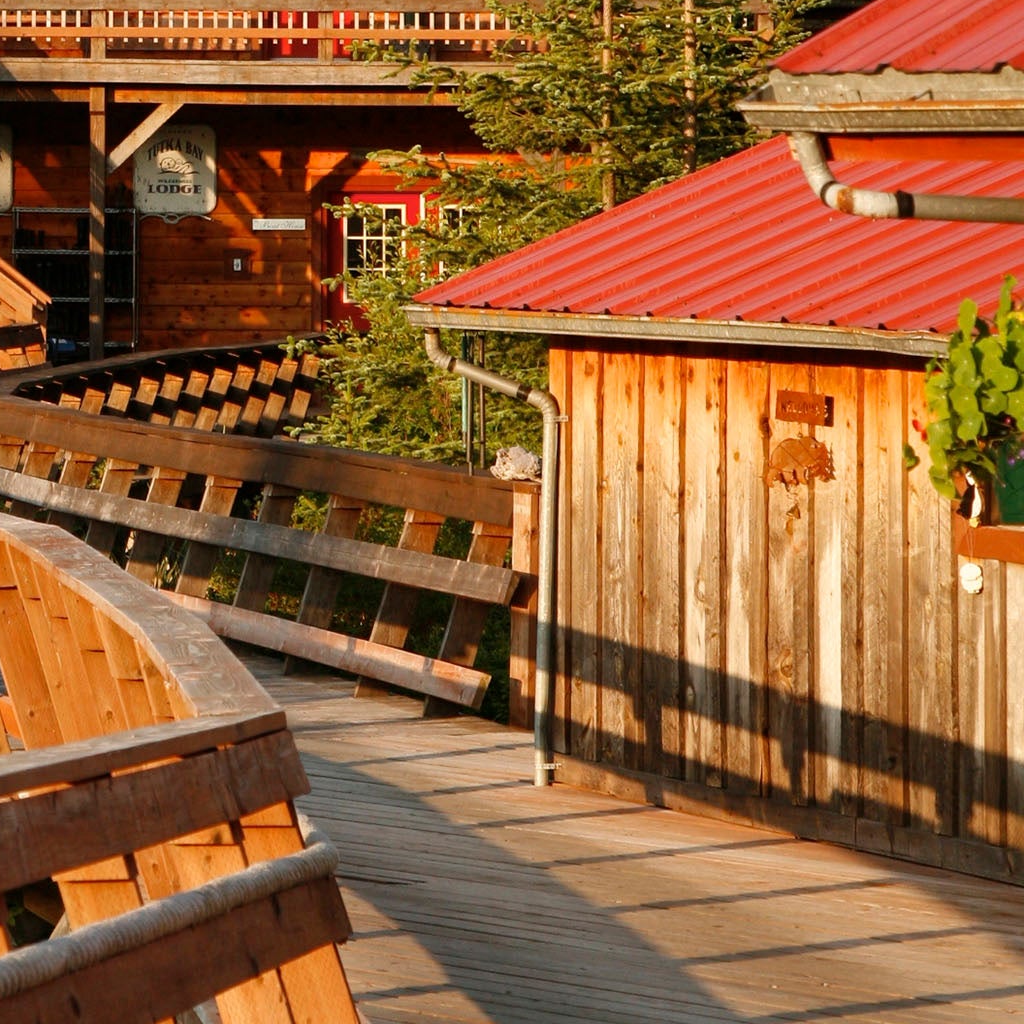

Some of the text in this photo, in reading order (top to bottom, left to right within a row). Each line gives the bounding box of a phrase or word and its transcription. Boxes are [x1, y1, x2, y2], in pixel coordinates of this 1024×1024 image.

[147, 137, 204, 161] TUTKA BAY
[147, 184, 203, 194] LODGE
